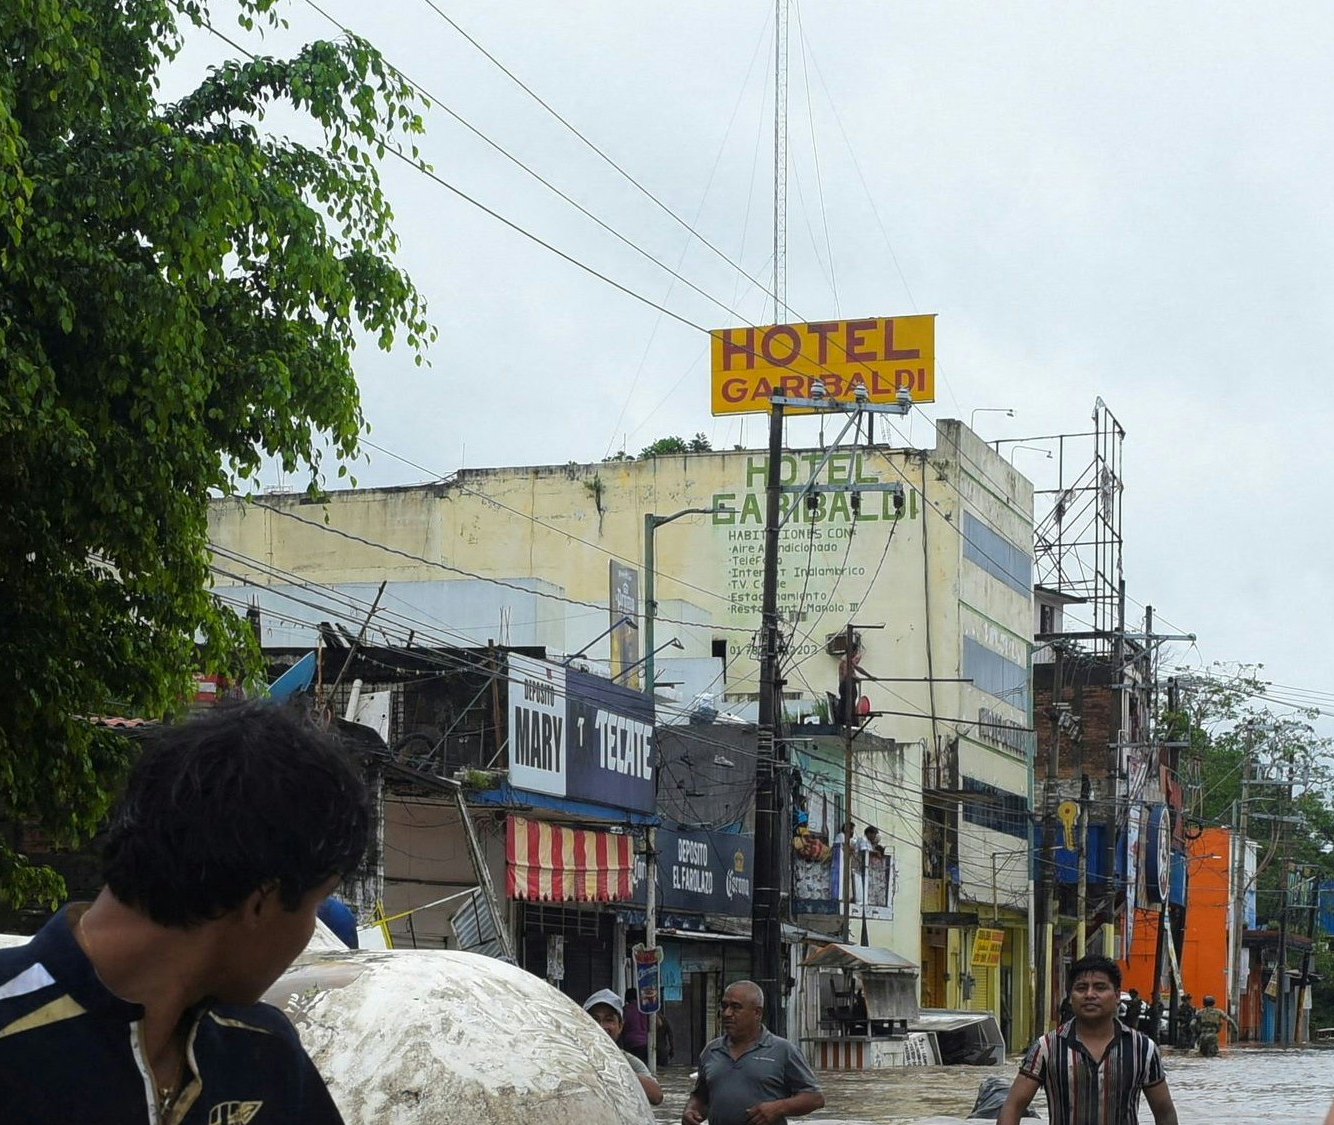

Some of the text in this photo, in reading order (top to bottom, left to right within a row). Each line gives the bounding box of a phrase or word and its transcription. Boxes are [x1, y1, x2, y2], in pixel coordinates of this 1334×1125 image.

[722, 319, 920, 371] HOTEL
[721, 368, 925, 403] GARIBALDI
[747, 453, 879, 487] HOTEL
[712, 488, 917, 525] GARIBALDI
[728, 529, 822, 540] HABITIONES
[758, 543, 838, 553] Andicionado
[524, 678, 555, 707] DEPOSITO
[515, 706, 563, 773] MARY
[595, 709, 653, 781] TECATE
[678, 838, 708, 867] DEPOSITO
[672, 865, 713, 895] EL FAROLAZO
